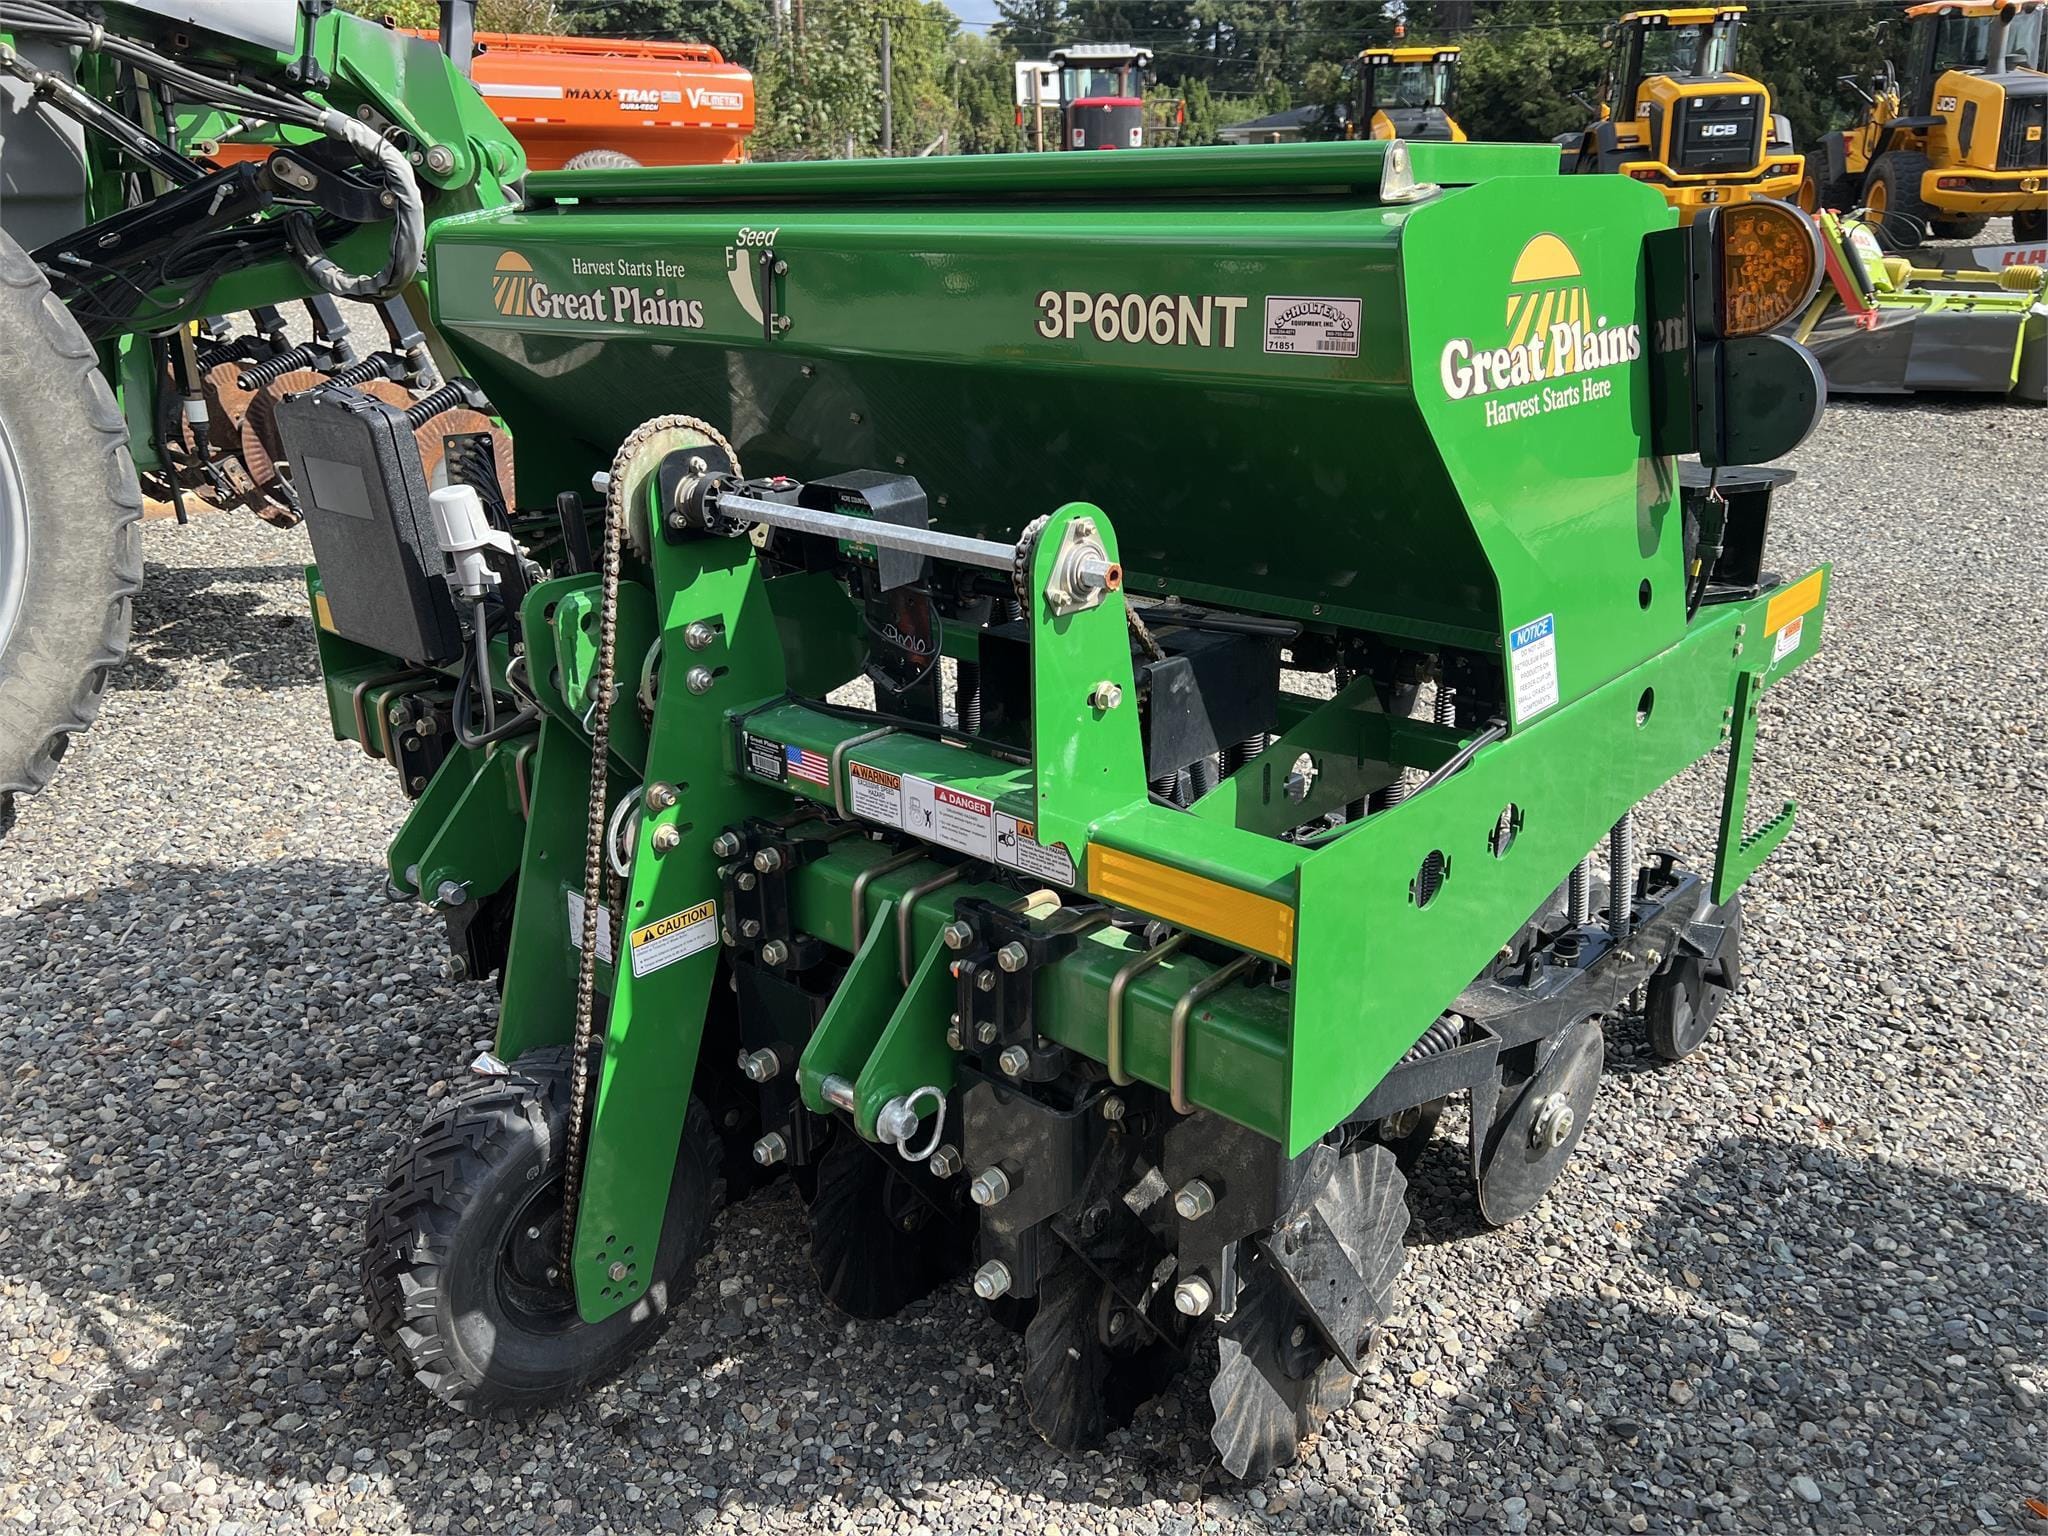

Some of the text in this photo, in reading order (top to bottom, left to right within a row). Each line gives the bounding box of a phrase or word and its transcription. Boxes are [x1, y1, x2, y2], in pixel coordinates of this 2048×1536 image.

[1936, 97, 1957, 112] JCB
[1701, 125, 1738, 136] JCB
[736, 227, 779, 247] Seed
[572, 258, 685, 278] Harvest Starts Here
[725, 246, 734, 268] F
[530, 282, 705, 328] Great Plains
[770, 313, 780, 334] E
[1036, 290, 1248, 349] 3P606NT
[1275, 302, 1353, 331] SCHOLTEN'S
[1269, 341, 1295, 350] 71851
[1441, 331, 1546, 400] Great
[1549, 316, 1641, 377] Plains
[1485, 377, 1612, 427] Harvest Starts Here
[1516, 619, 1549, 646] NOTICE
[860, 766, 900, 789] WARNING
[949, 794, 987, 814] DANGER
[656, 906, 708, 935] CAUTION
